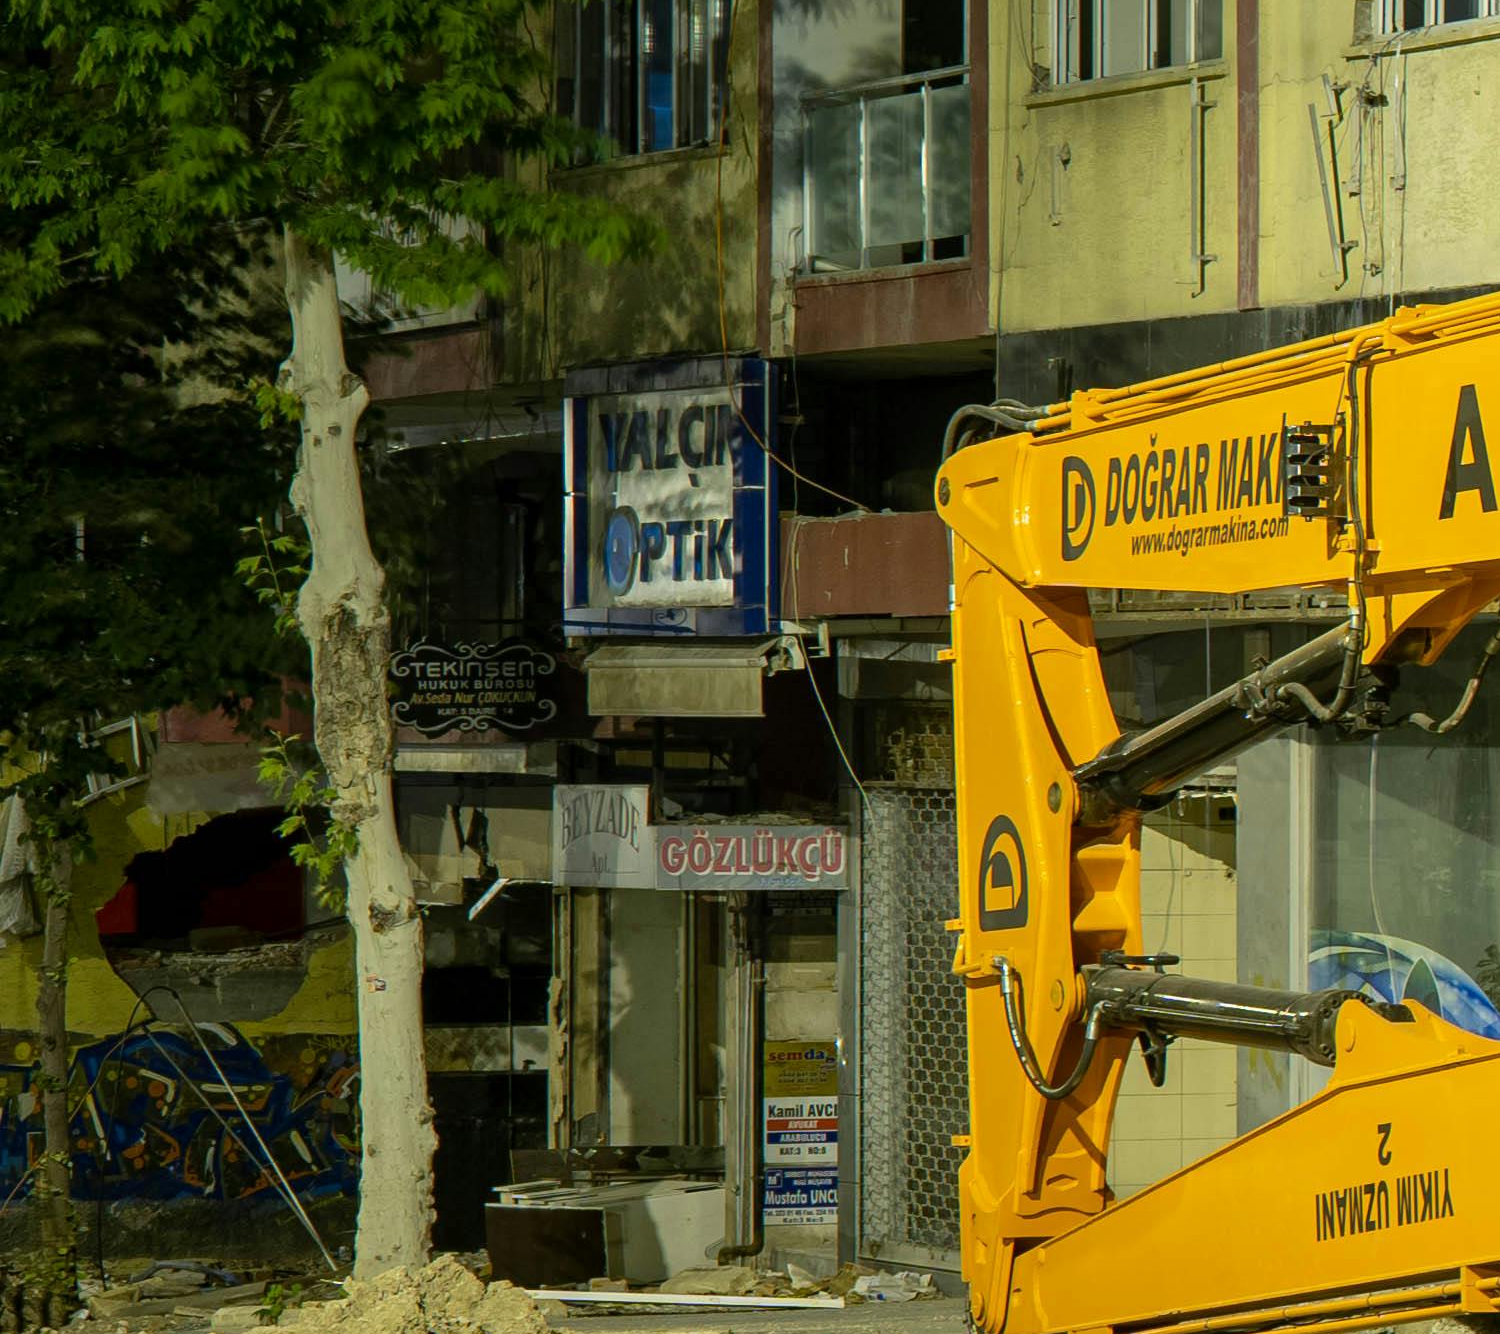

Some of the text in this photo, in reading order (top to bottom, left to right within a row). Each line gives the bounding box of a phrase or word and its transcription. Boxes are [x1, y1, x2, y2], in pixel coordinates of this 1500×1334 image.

[1104, 433, 1210, 527] DOĞRAR
[1131, 515, 1289, 557] www.dograrmakina.com
[418, 680, 469, 690] HUKUK
[562, 790, 640, 854] BEYZADE
[661, 827, 845, 881] GÖZLÜKÇÜ
[768, 1104, 804, 1118] Kamil
[1377, 1123, 1392, 1166] 2
[764, 1189, 807, 1205] Mustafa
[1315, 1168, 1455, 1242] YIKIM UZMANI
